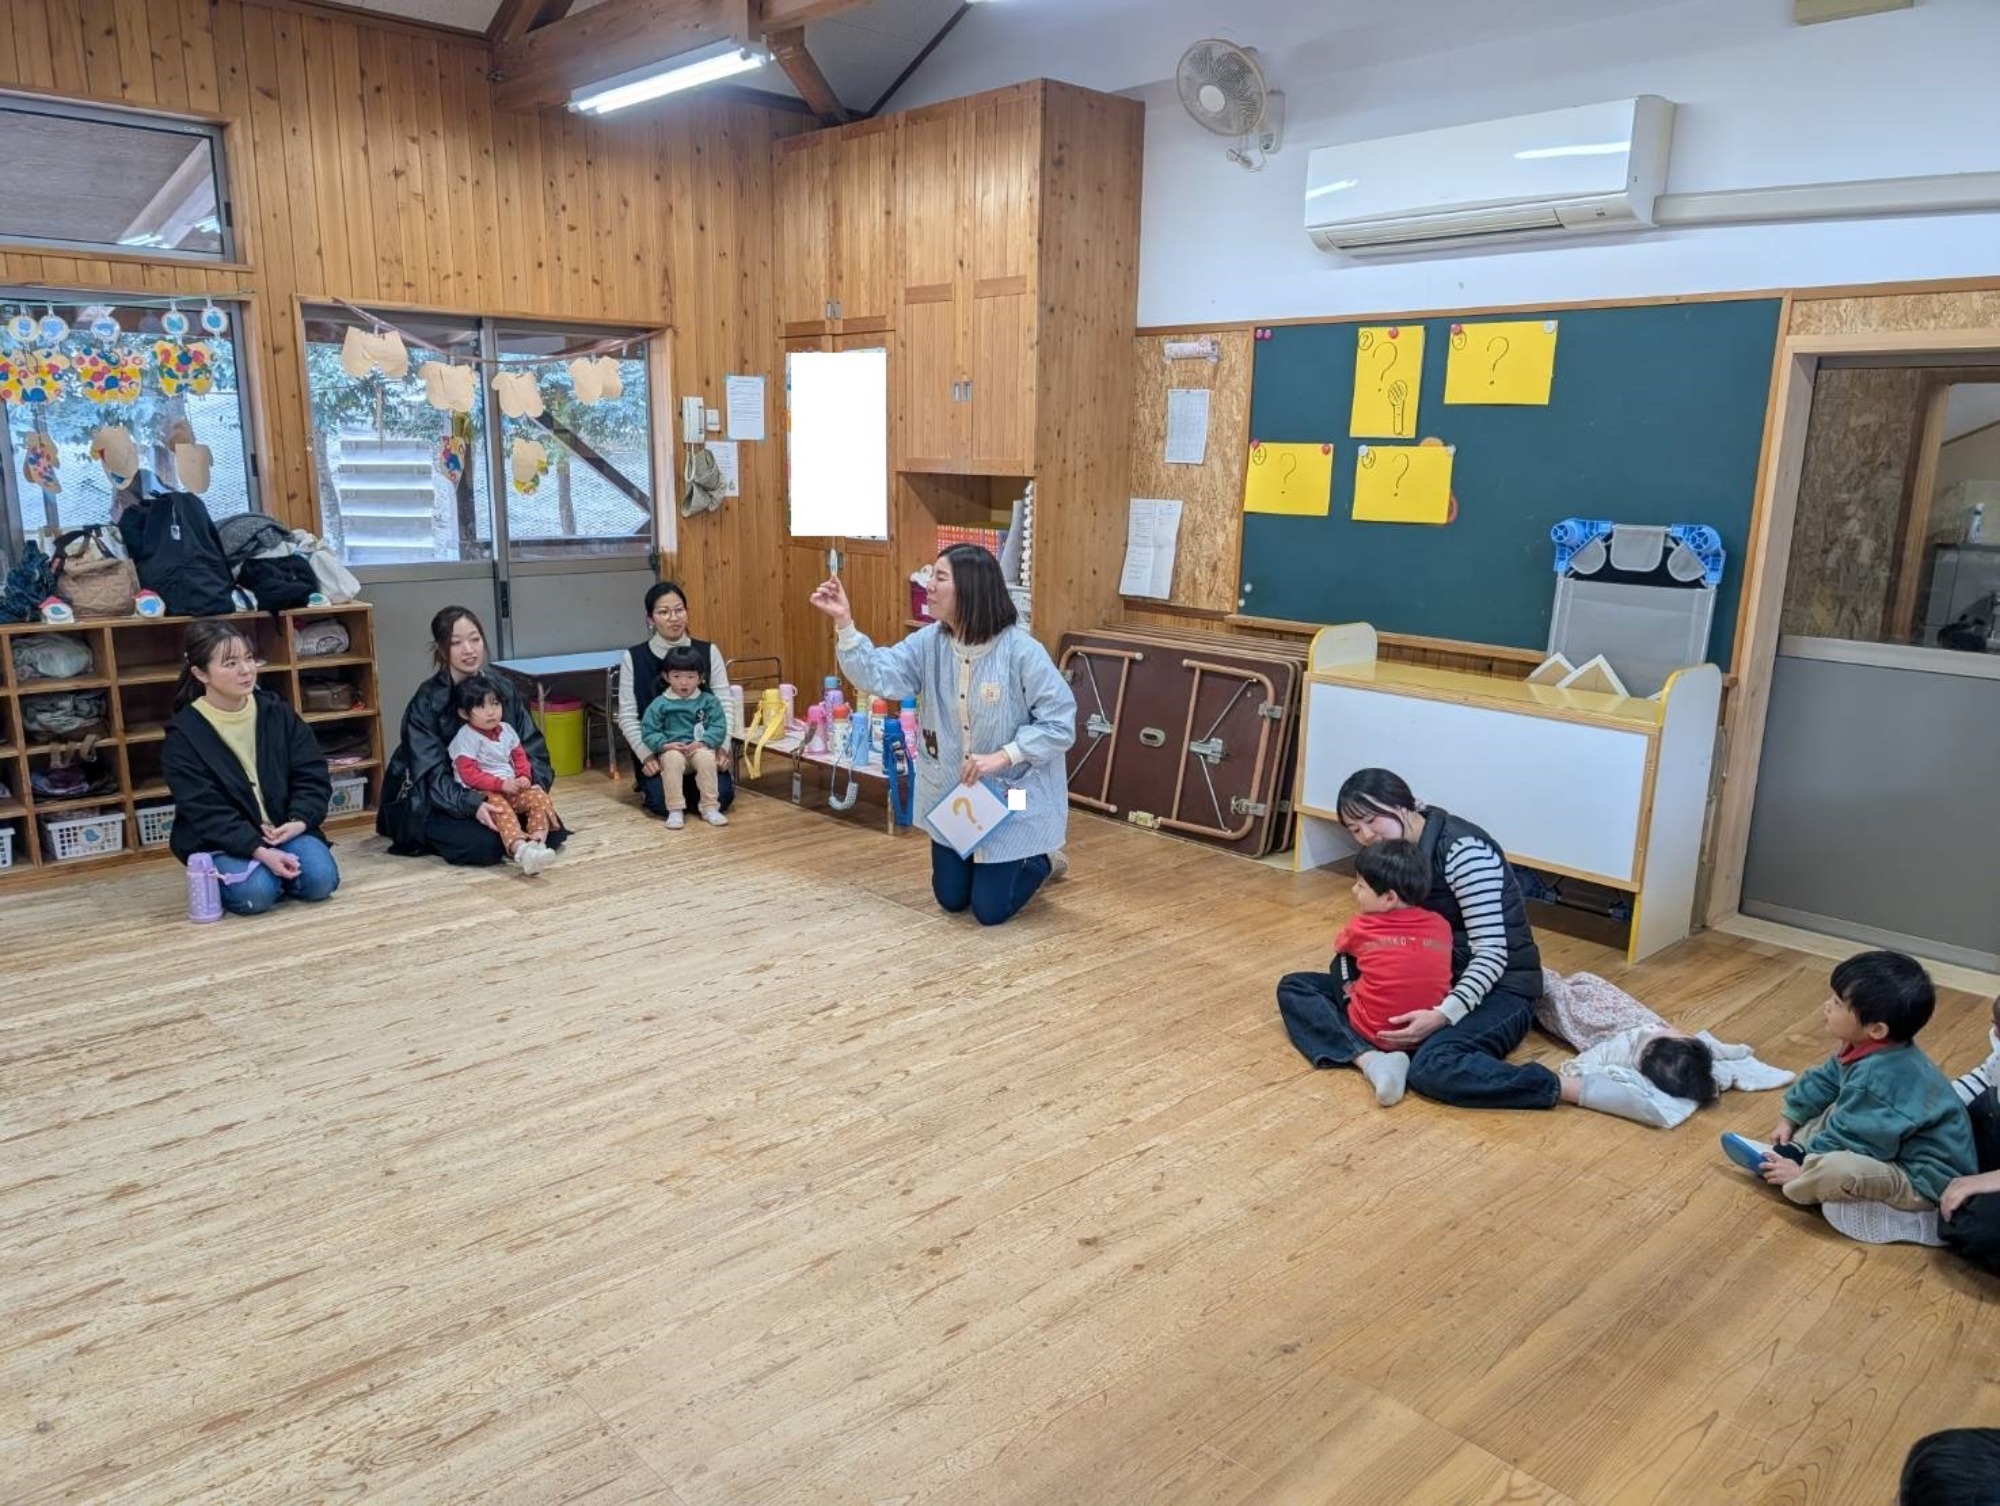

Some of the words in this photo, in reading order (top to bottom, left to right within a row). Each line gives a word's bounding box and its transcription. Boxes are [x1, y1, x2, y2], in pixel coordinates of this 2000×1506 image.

[1372, 341, 1398, 393] ?
[1487, 336, 1510, 385] ?
[1280, 452, 1297, 495] ?
[1392, 453, 1410, 497] ?
[953, 796, 983, 831] ?
